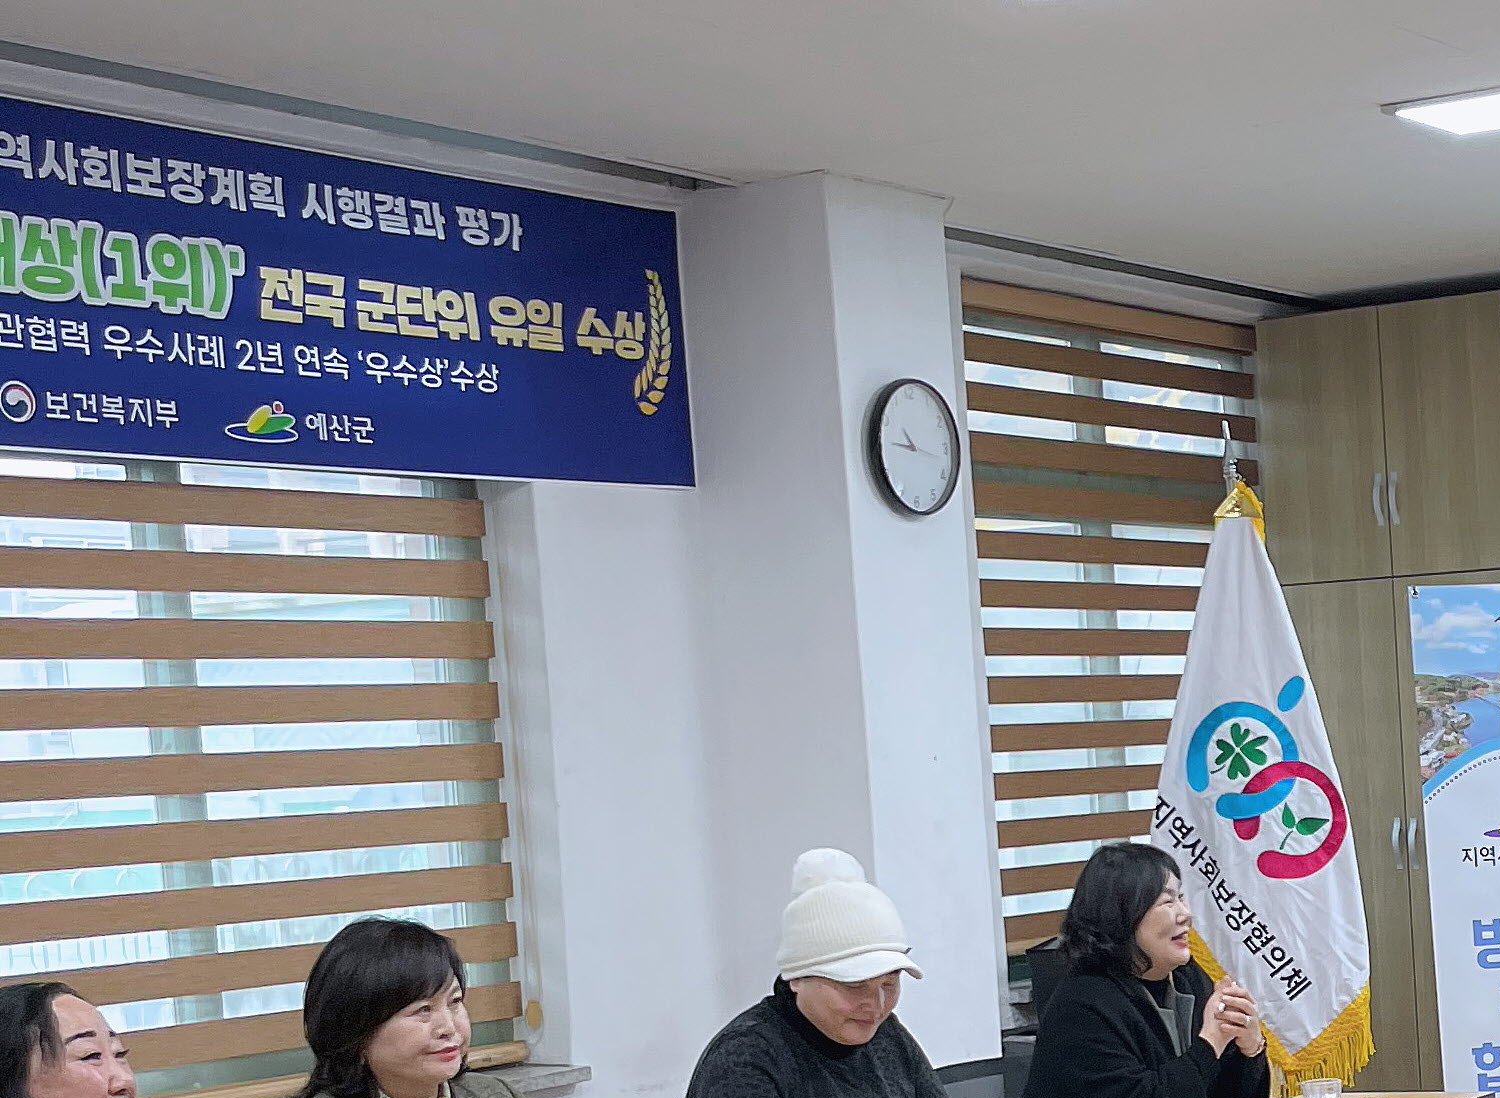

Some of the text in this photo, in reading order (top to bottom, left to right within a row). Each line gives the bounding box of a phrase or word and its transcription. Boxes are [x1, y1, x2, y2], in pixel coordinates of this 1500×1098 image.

[0, 130, 523, 252] 역사회보장계획 시행결과 평가
[0, 313, 91, 356] 관협력
[104, 325, 226, 369] 우수사례
[235, 338, 285, 374] 2년
[294, 344, 350, 381] 연속
[259, 266, 346, 328] 전국
[356, 278, 481, 342] 군단위
[488, 295, 564, 352] 유일
[576, 307, 646, 360] 수상
[46, 391, 179, 429] 보건복지부
[304, 412, 375, 444] 예산군
[1154, 795, 1312, 1001] 지역사회보장협의체
